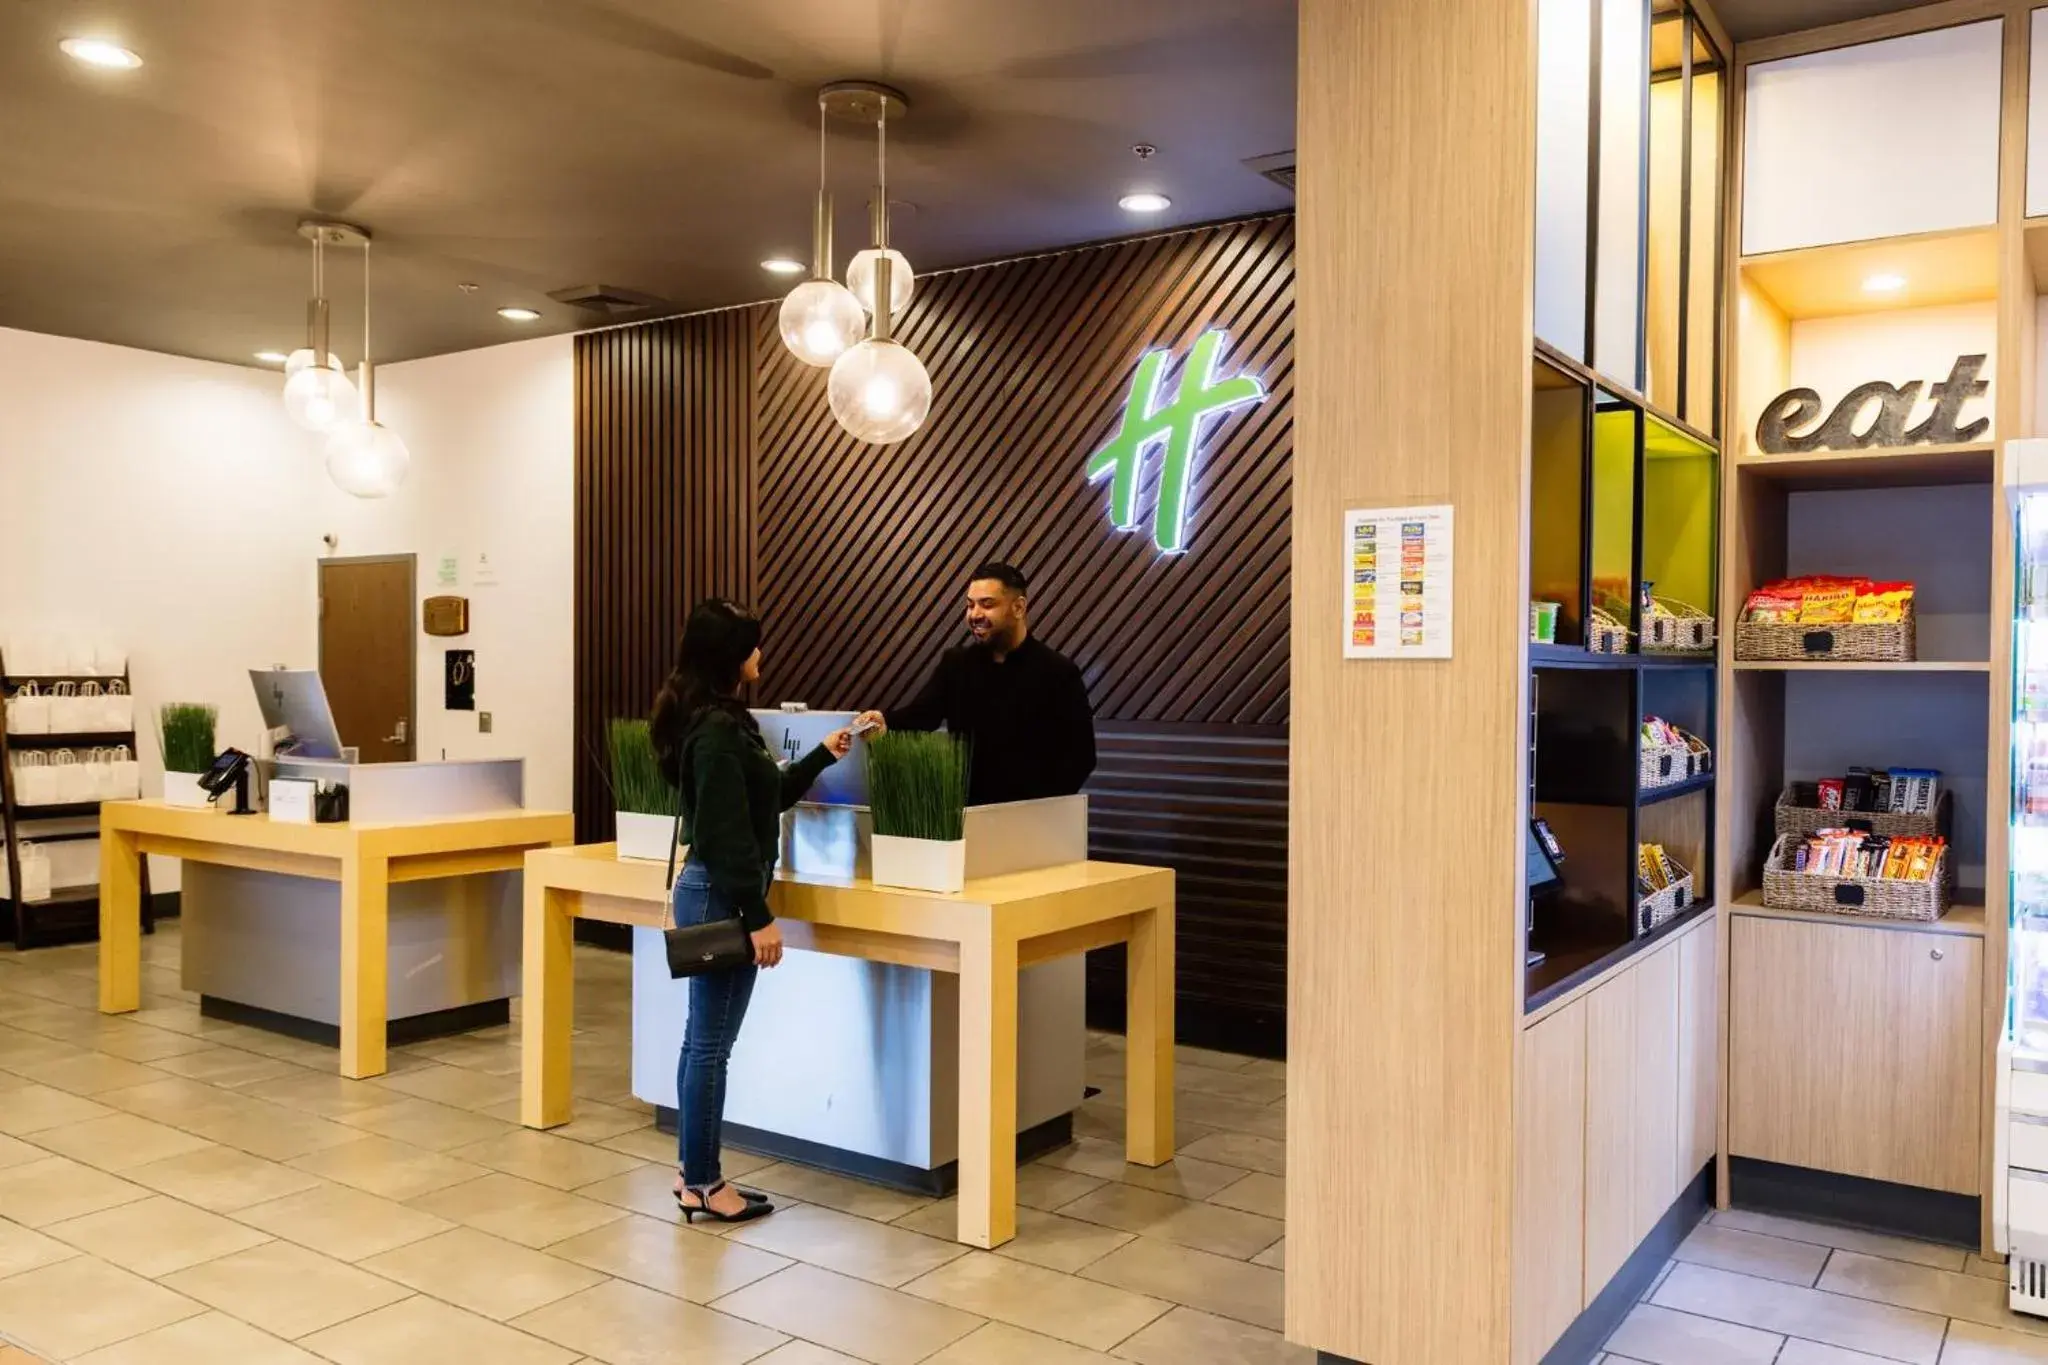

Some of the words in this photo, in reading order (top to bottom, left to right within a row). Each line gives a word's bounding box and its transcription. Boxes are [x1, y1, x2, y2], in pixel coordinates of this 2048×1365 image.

[1756, 353, 1990, 454] eat
[1087, 329, 1266, 553] H
[1805, 592, 1849, 602] HARIBO
[783, 728, 800, 761] hp
